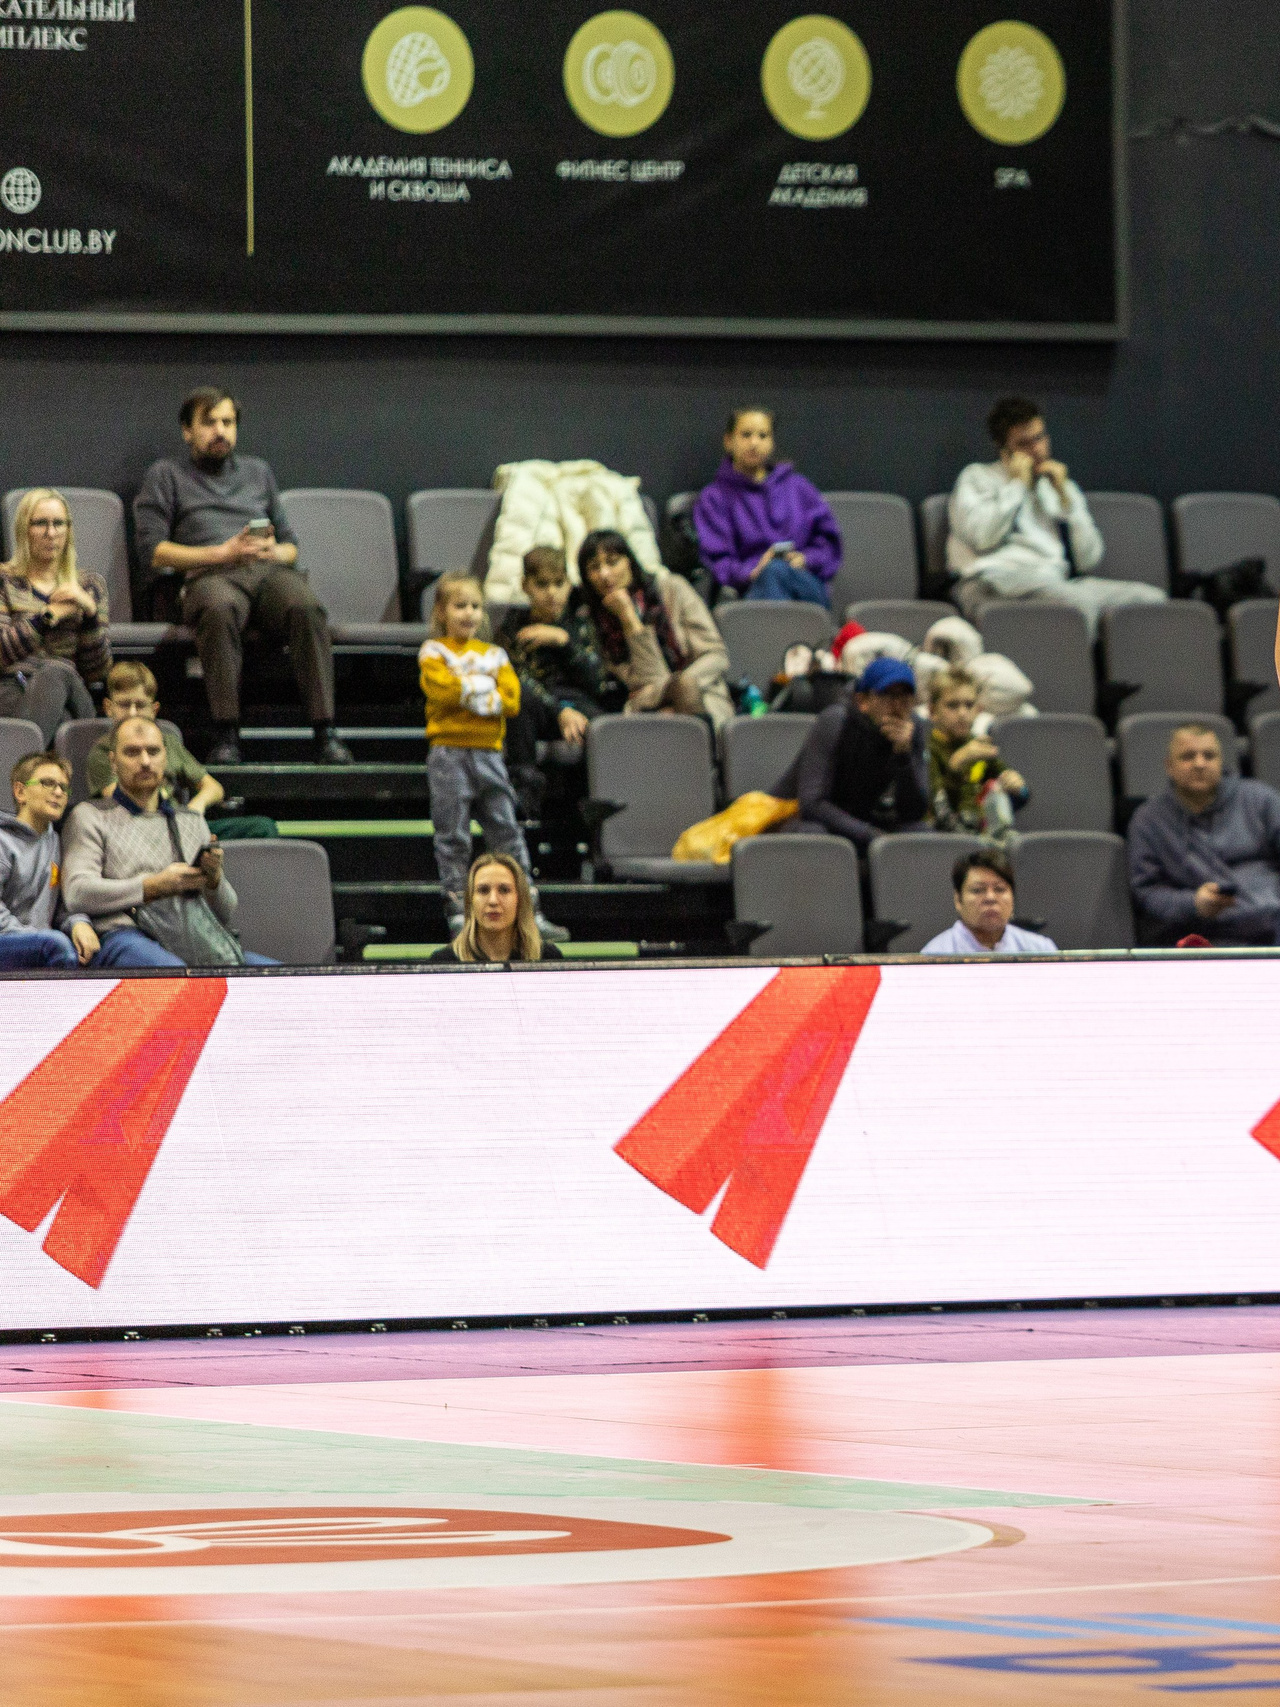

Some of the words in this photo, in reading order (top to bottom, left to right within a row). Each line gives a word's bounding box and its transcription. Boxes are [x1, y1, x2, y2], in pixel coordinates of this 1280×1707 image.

[326, 154, 428, 178] АКАДЕМИЯ
[429, 156, 514, 181] ТЕННИСА
[555, 159, 630, 182] ФИТНЕС
[630, 160, 686, 182] ЦЕНТР
[776, 161, 860, 185] ДЕТСКАЯ
[369, 178, 386, 201] И
[387, 178, 472, 203] СКВОША
[767, 185, 869, 209] АКАДЕМИЯ
